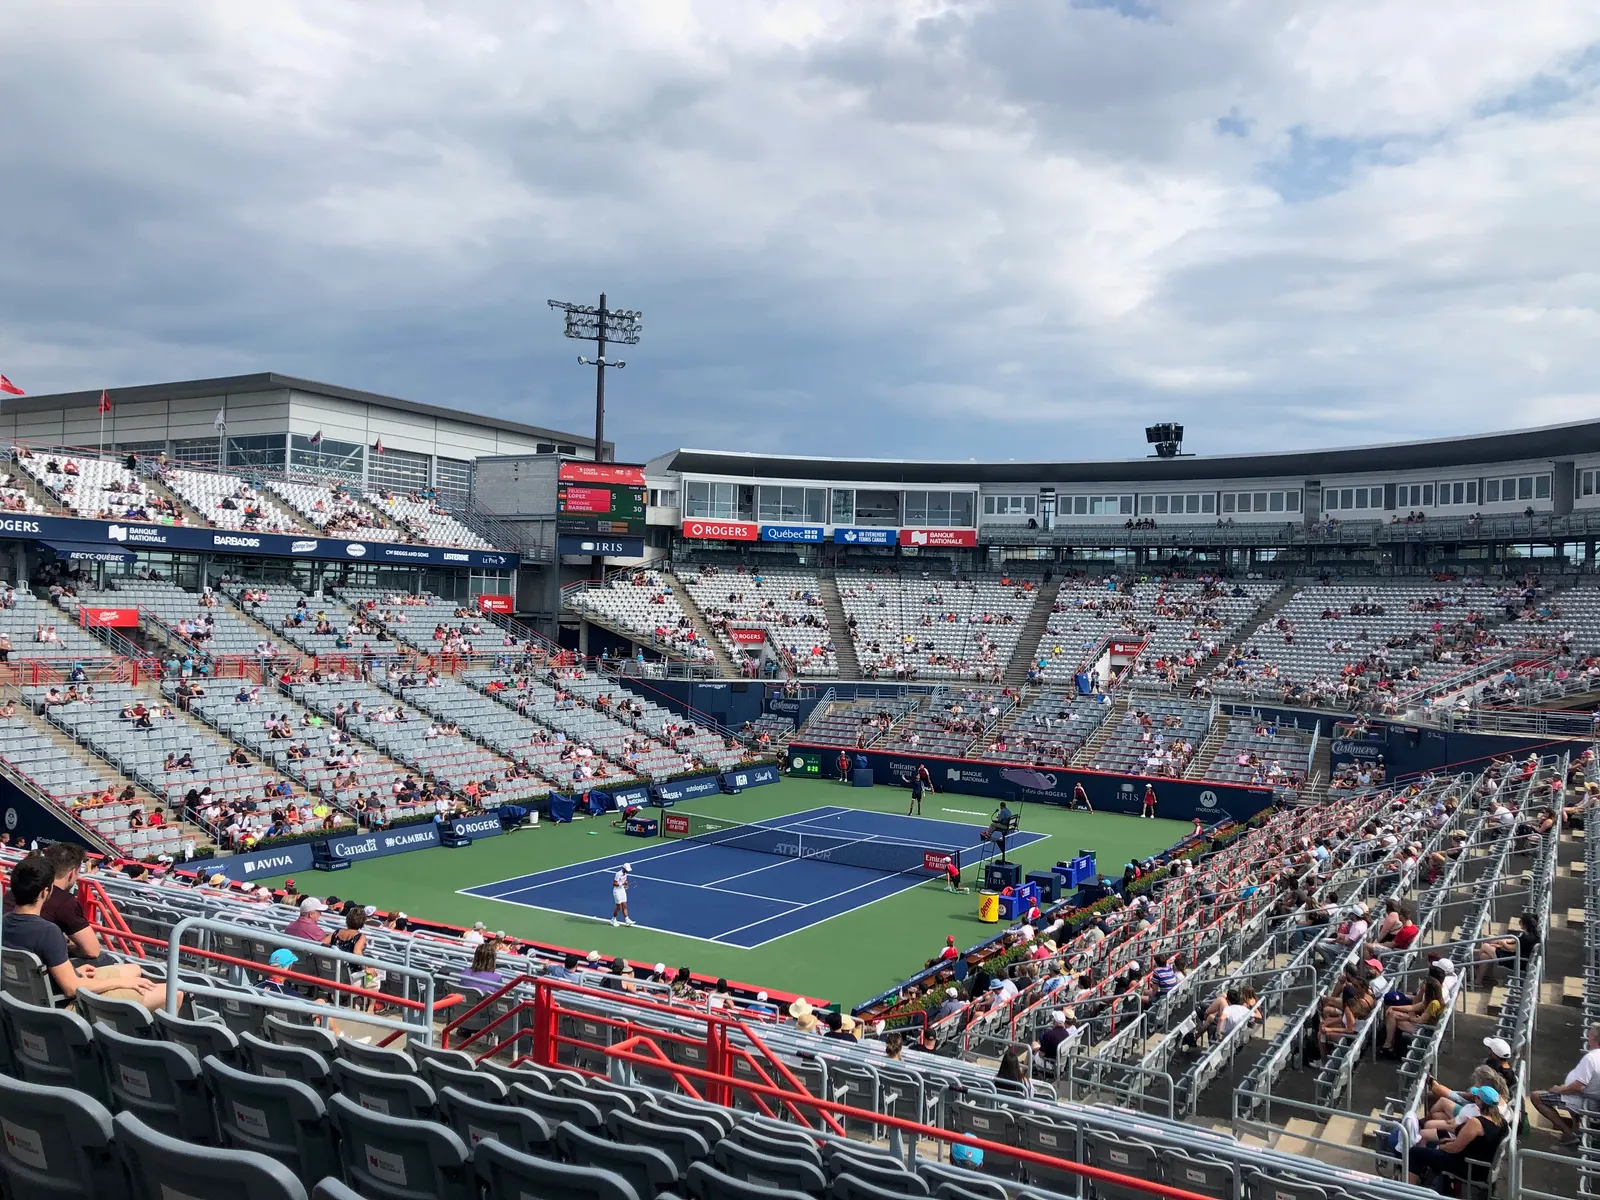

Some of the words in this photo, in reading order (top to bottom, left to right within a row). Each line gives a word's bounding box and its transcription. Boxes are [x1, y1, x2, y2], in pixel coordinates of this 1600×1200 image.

[129, 527, 158, 535] BANQUE
[705, 525, 748, 536] ROGERS
[768, 528, 804, 539] Québec
[129, 534, 167, 543] NATIONALE
[214, 535, 260, 547] BARBADOS
[596, 542, 623, 552] IRIS
[70, 552, 125, 561] RECYC-QUÉBEC
[1331, 740, 1379, 756] Cashmere
[889, 762, 917, 771] Emirates
[736, 774, 748, 786] IGA
[961, 776, 989, 784] NATIONALE
[1116, 792, 1139, 801] IRIS
[466, 820, 500, 834] ROGERS
[666, 817, 688, 827] Emirates
[626, 823, 646, 833] FedEx
[395, 831, 435, 846] CAMBRIA
[335, 838, 378, 857] Canada
[257, 855, 293, 870] AVIVA
